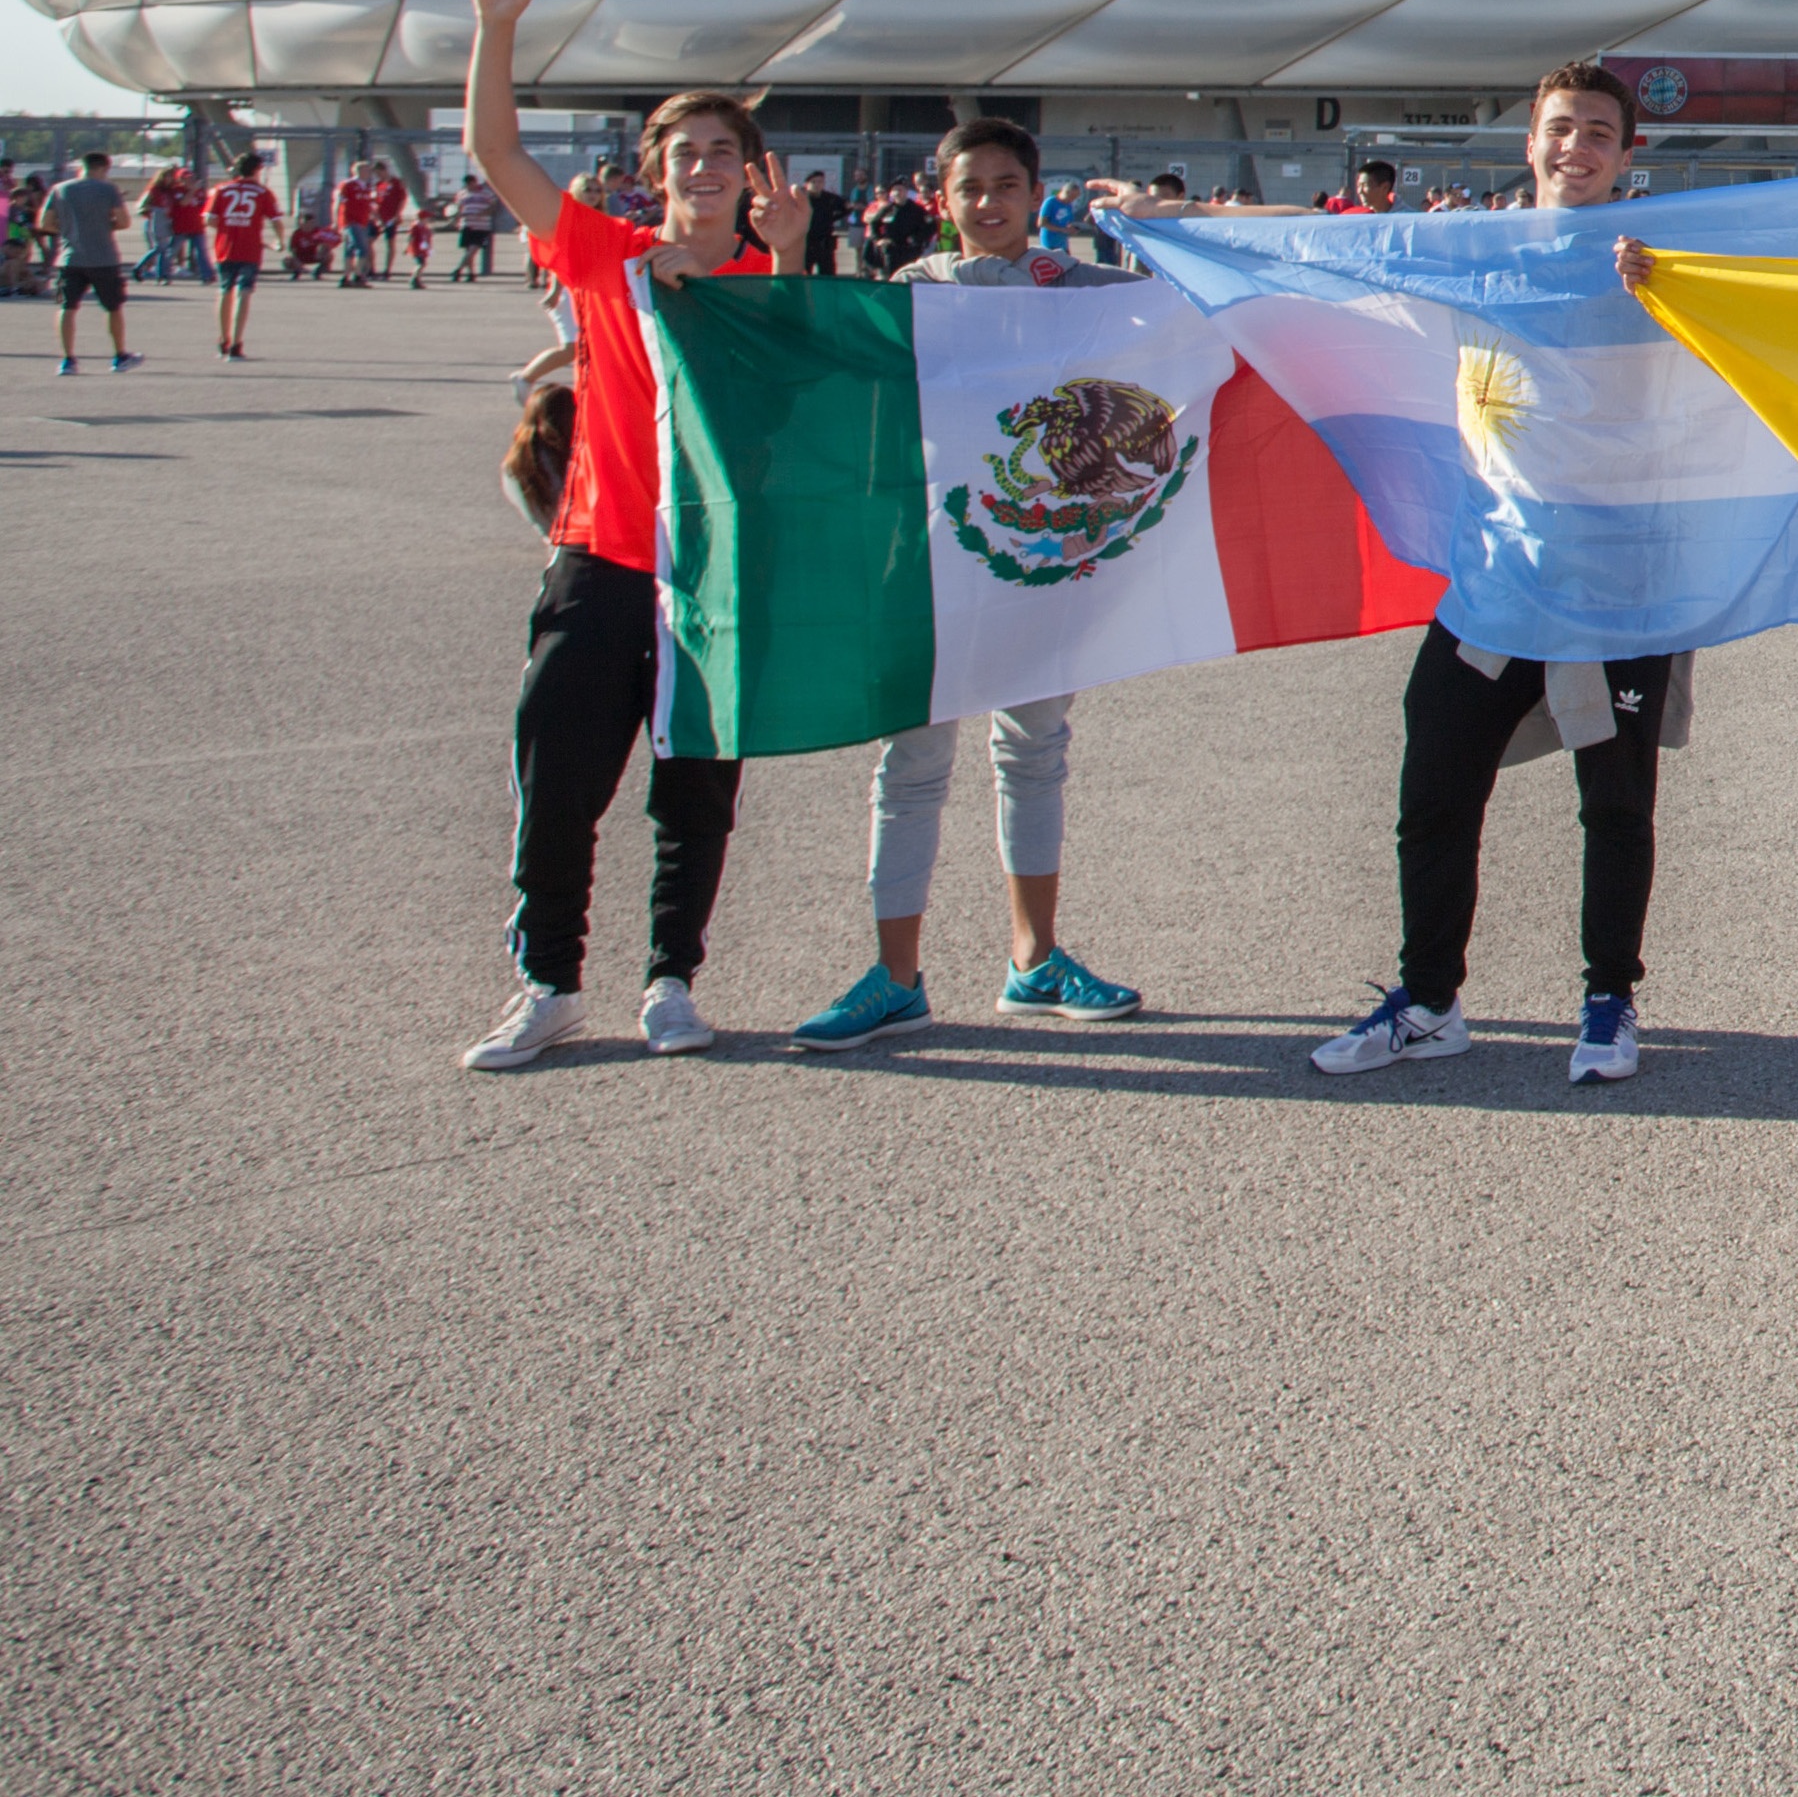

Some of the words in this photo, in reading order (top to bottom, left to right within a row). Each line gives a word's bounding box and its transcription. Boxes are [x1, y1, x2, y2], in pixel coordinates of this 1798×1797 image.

[1316, 97, 1341, 130] D
[1404, 171, 1419, 183] 28
[1633, 173, 1647, 186] 27
[222, 189, 257, 218] 25
